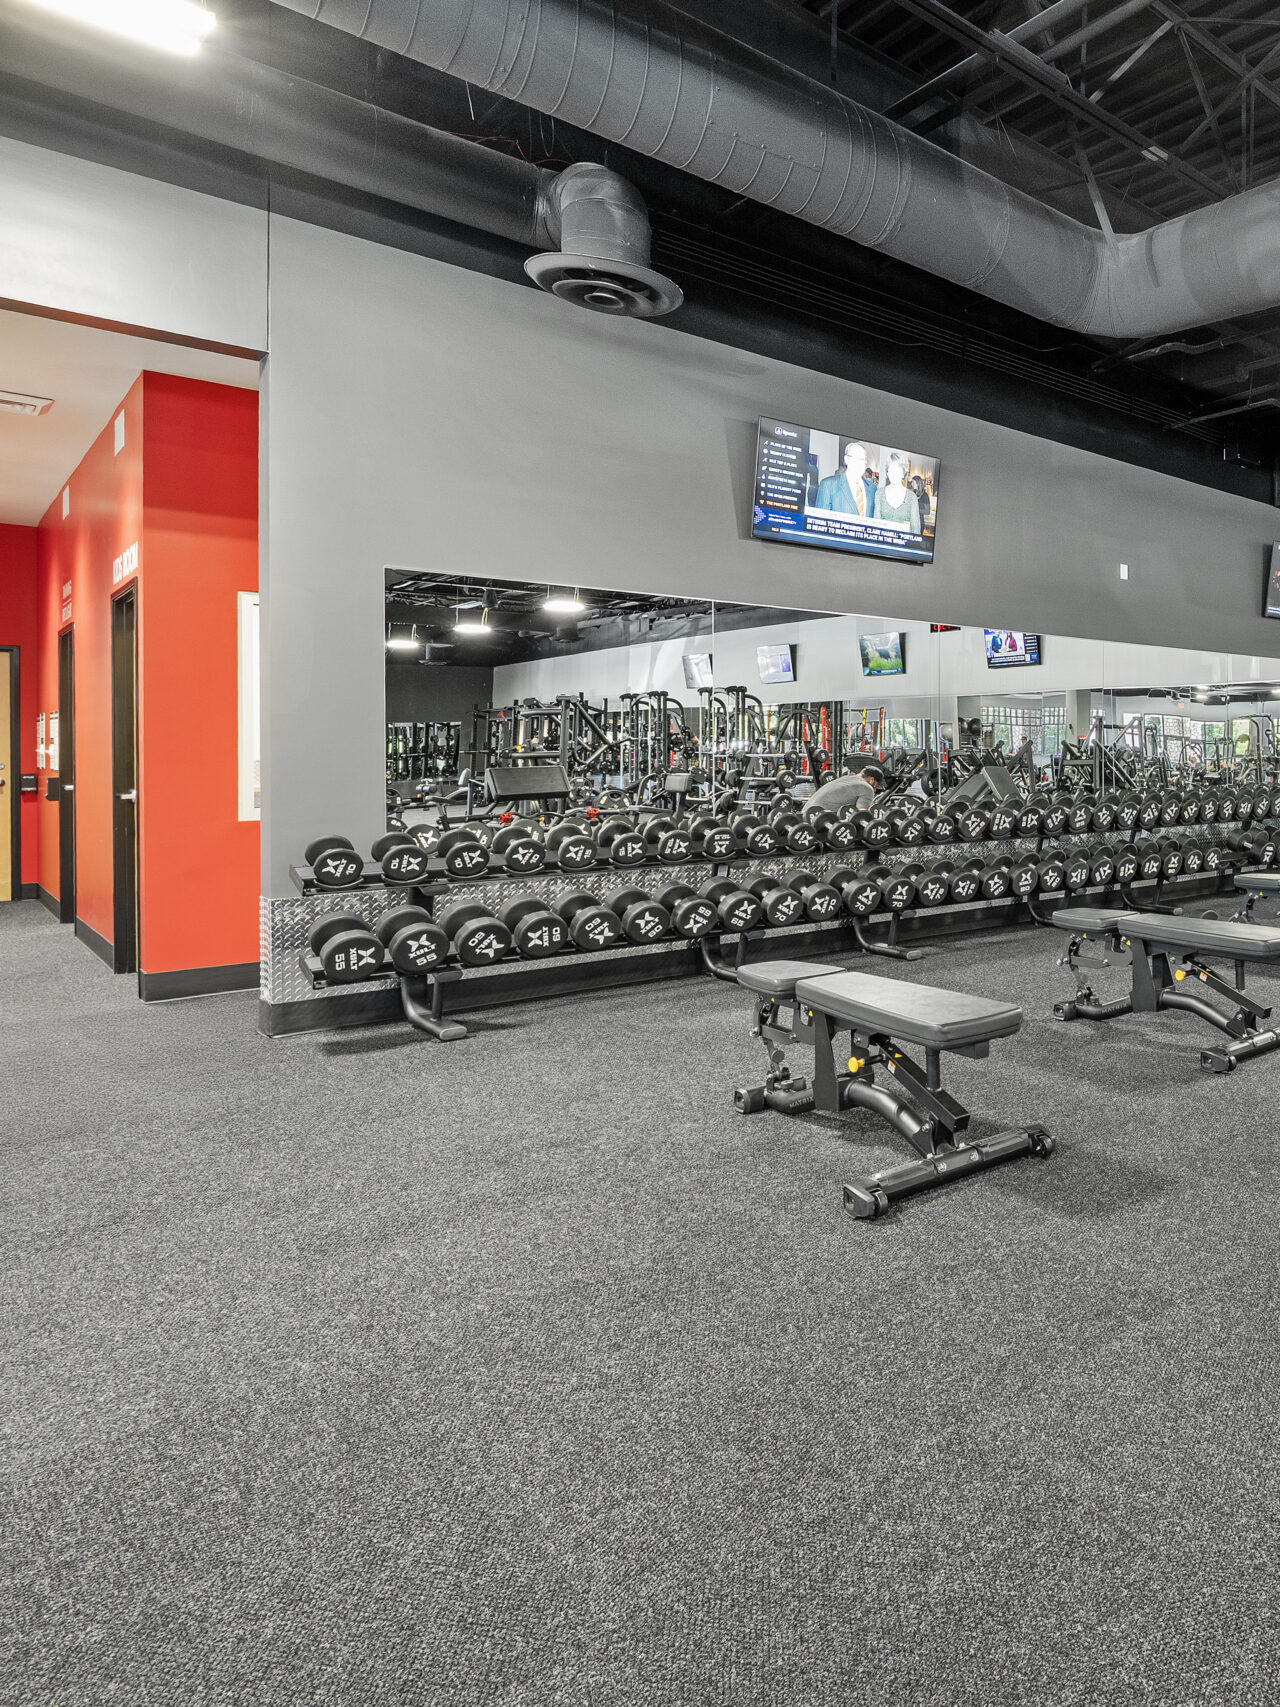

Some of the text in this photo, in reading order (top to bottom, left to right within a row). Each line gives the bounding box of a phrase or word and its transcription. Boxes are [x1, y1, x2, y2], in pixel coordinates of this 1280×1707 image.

[113, 541, 138, 585] KIDS ROOM
[521, 848, 534, 864] XULT
[575, 844, 585, 861] XULT
[584, 850, 592, 859] 15
[619, 846, 625, 856] 15
[391, 858, 399, 869] 10
[401, 854, 409, 872] XULT
[454, 857, 463, 868] 10
[462, 851, 472, 868] XULT
[531, 853, 540, 864] 10
[335, 858, 347, 877] XULT
[346, 864, 356, 875] 10
[857, 895, 872, 905] XULT
[935, 888, 944, 899] 75
[697, 906, 712, 917] 65
[777, 903, 794, 916] XULT
[828, 899, 836, 911] 70
[855, 902, 865, 911] 70
[690, 913, 708, 925] XULT
[734, 909, 752, 920] XULT
[774, 912, 787, 922] 70
[585, 918, 601, 931] 60
[640, 916, 660, 934] XULT
[730, 917, 744, 927] 65
[553, 927, 560, 941] 60
[588, 921, 610, 939] XULT
[648, 925, 663, 938] 60
[468, 932, 485, 947] 60
[475, 934, 496, 954] XULT
[408, 943, 436, 959] XULT
[335, 953, 345, 970] 55
[350, 947, 358, 970] XULT
[416, 953, 437, 966] 55
[1102, 1002, 1127, 1013] MATRIX
[789, 1096, 814, 1108] MATRIX
